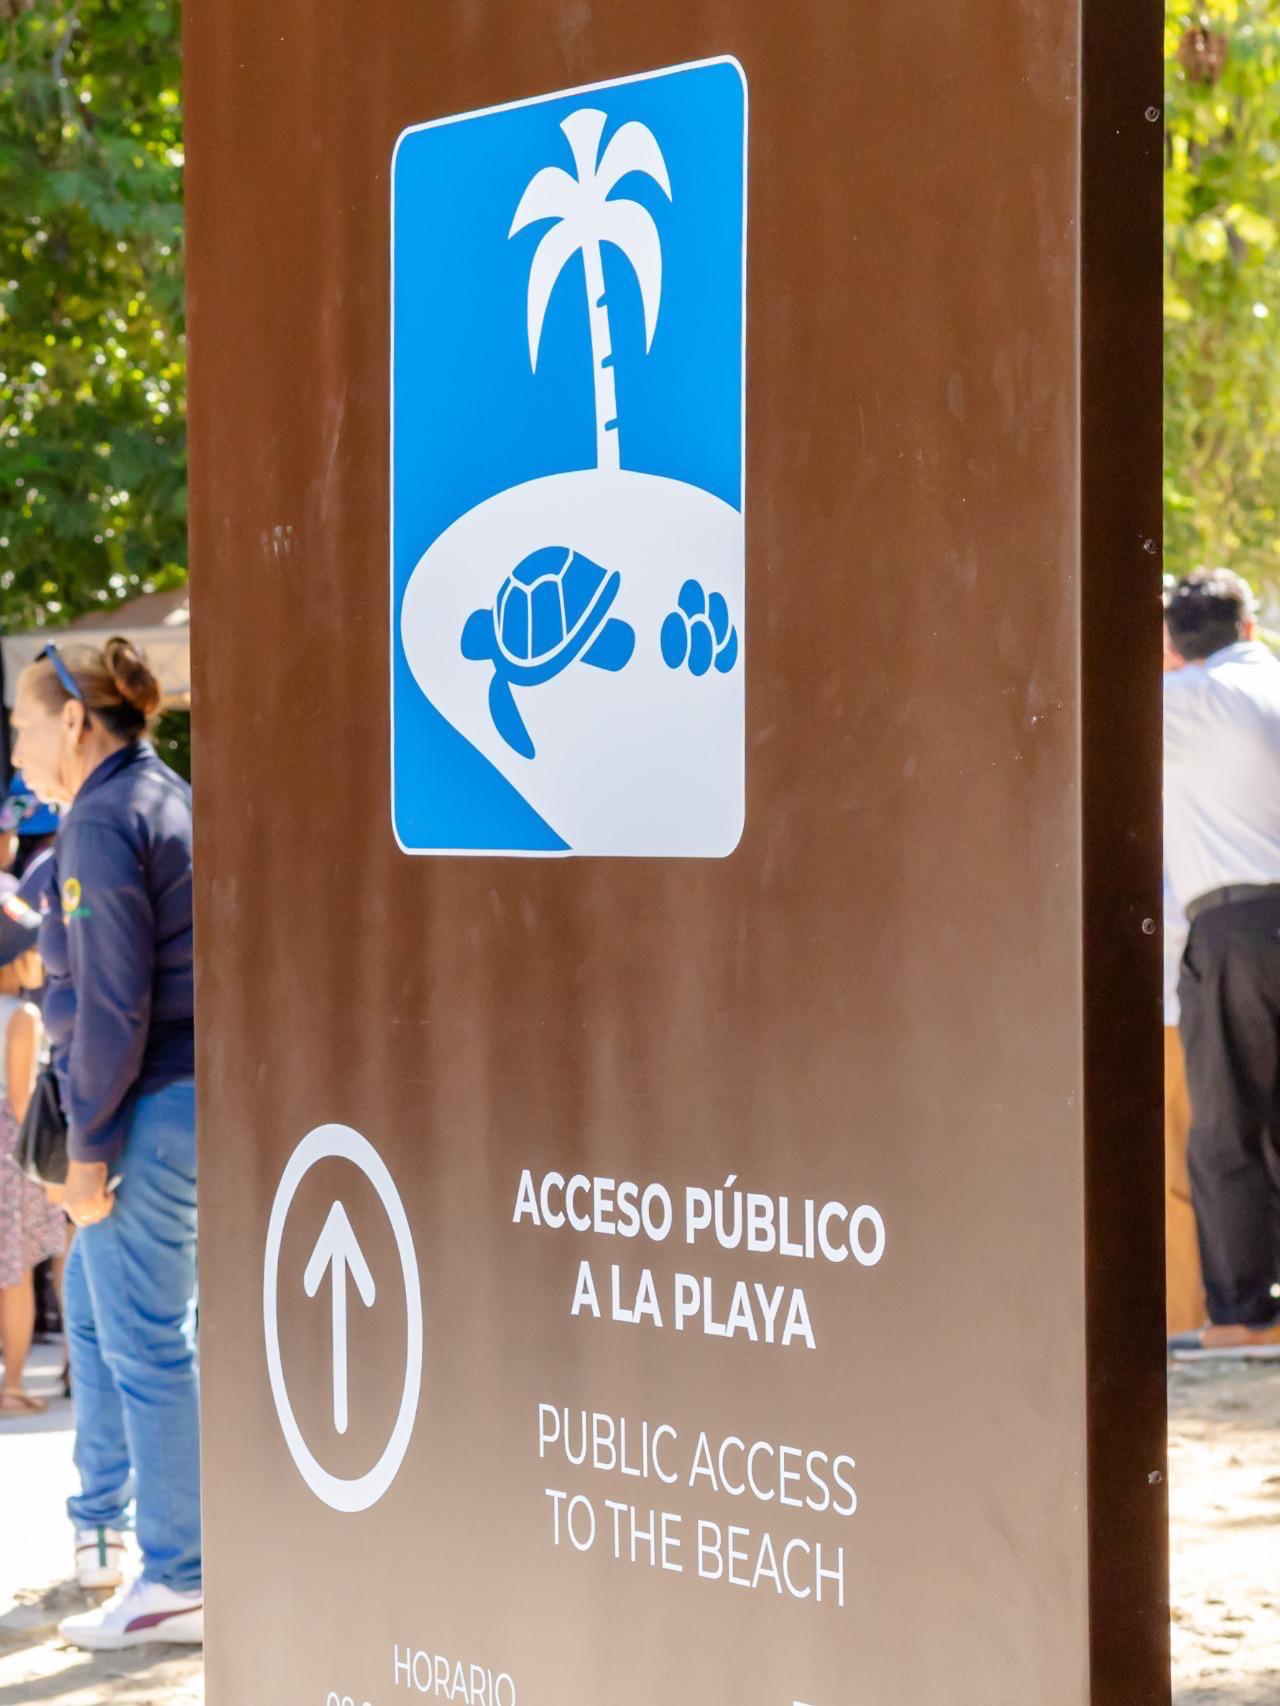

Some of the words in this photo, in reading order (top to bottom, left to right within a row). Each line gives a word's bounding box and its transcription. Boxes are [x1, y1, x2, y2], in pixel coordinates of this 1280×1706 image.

[512, 1168, 673, 1242] ACCESO
[685, 1174, 886, 1267] PÚBLICO
[570, 1260, 602, 1318] A
[611, 1264, 664, 1328] LA
[674, 1272, 817, 1350] PLAYA
[538, 1402, 679, 1484] PUBLIC
[688, 1431, 858, 1517] ACCESS
[544, 1488, 596, 1552] TO
[604, 1499, 683, 1573] THE
[697, 1519, 845, 1607] BEACH
[394, 1644, 516, 1706] HORARIO
